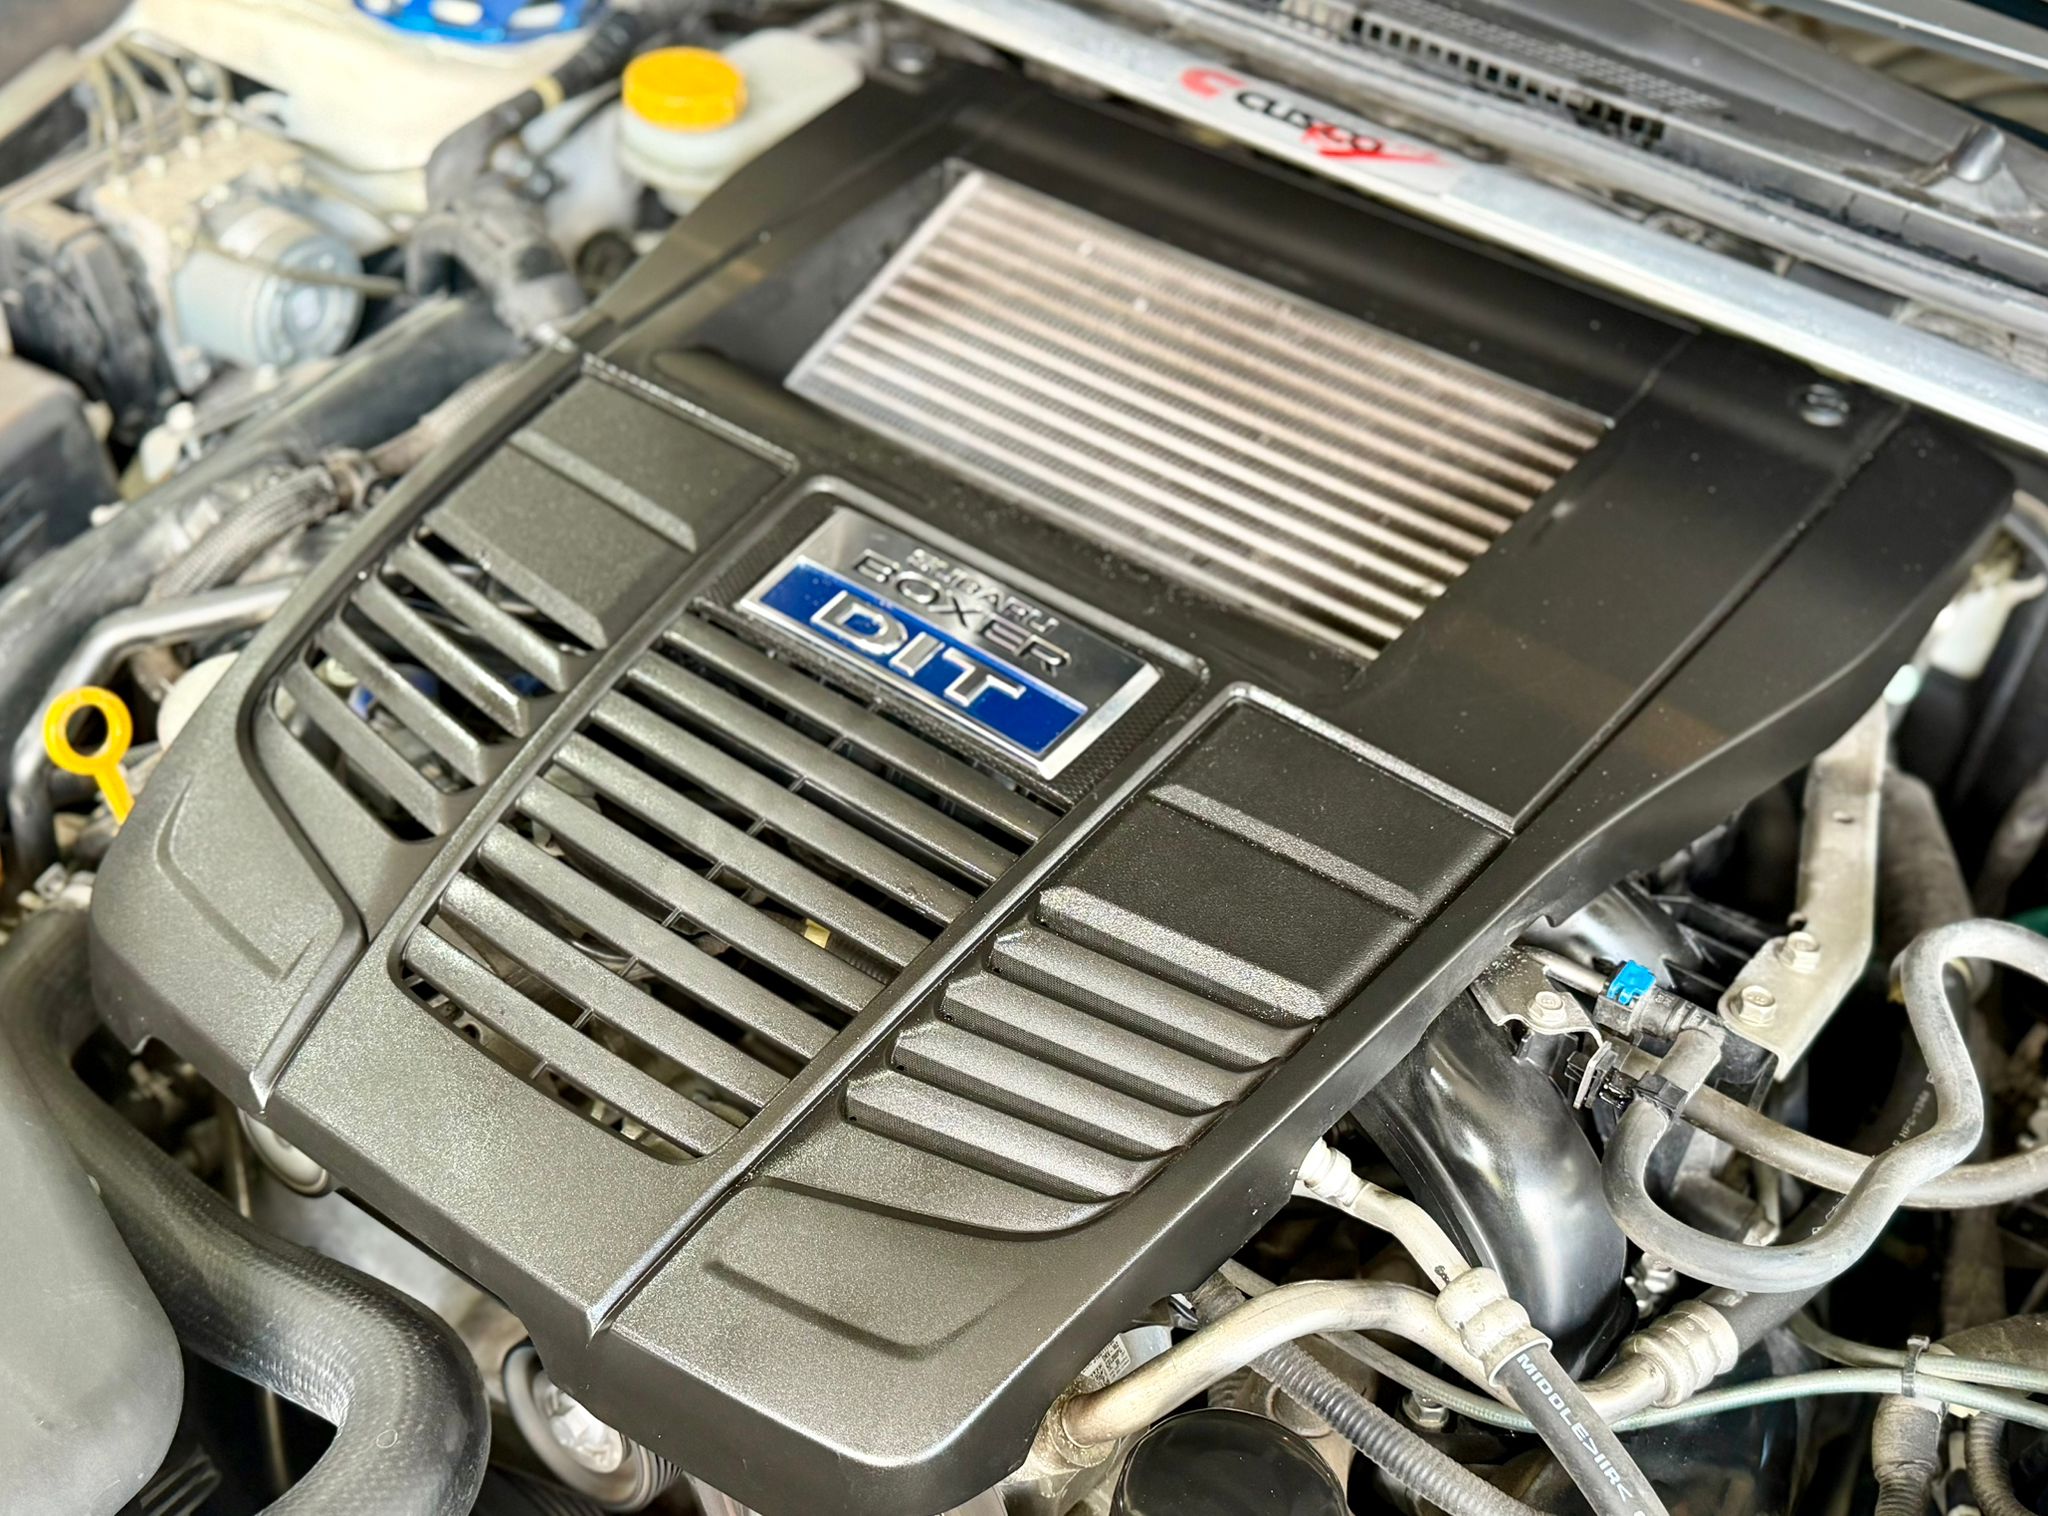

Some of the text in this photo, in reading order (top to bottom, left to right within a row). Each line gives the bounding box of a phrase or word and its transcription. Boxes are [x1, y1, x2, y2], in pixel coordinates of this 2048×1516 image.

[810, 589, 1027, 708] DIT
[853, 548, 1072, 677] BOXER
[906, 548, 1059, 633] SUBARU
